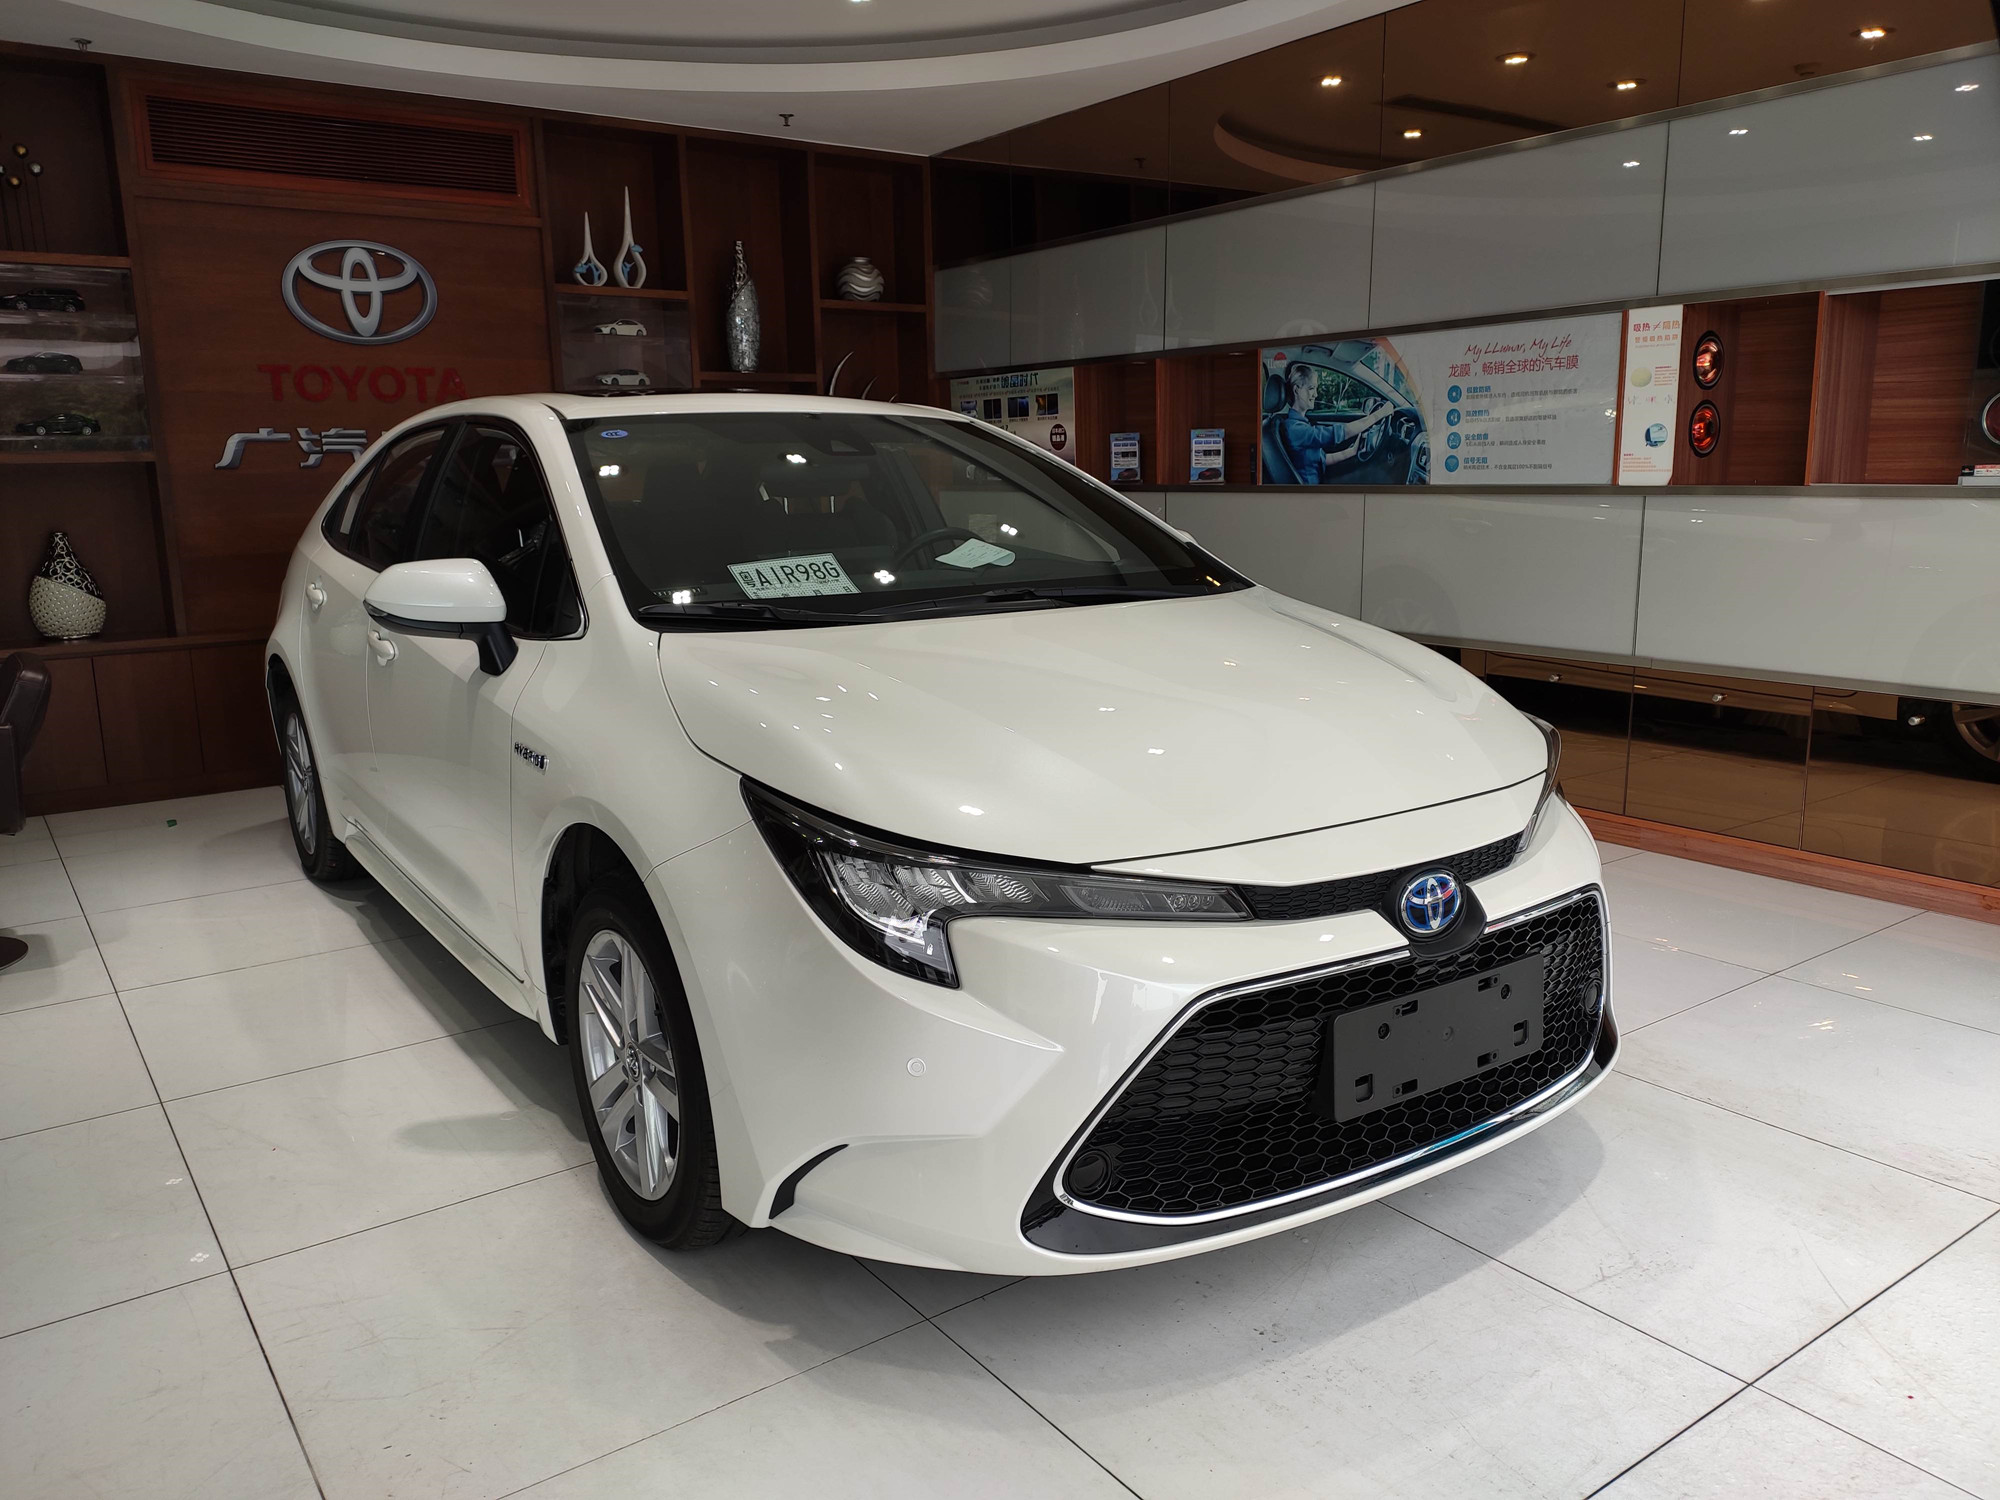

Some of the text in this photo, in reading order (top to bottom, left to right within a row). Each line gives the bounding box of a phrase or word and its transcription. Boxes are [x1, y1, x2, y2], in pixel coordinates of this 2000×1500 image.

[1465, 344, 1482, 363] My
[1530, 338, 1549, 358] My
[1551, 333, 1572, 354] Life
[256, 363, 468, 403] TOYOTA
[215, 427, 392, 469] 广汽
